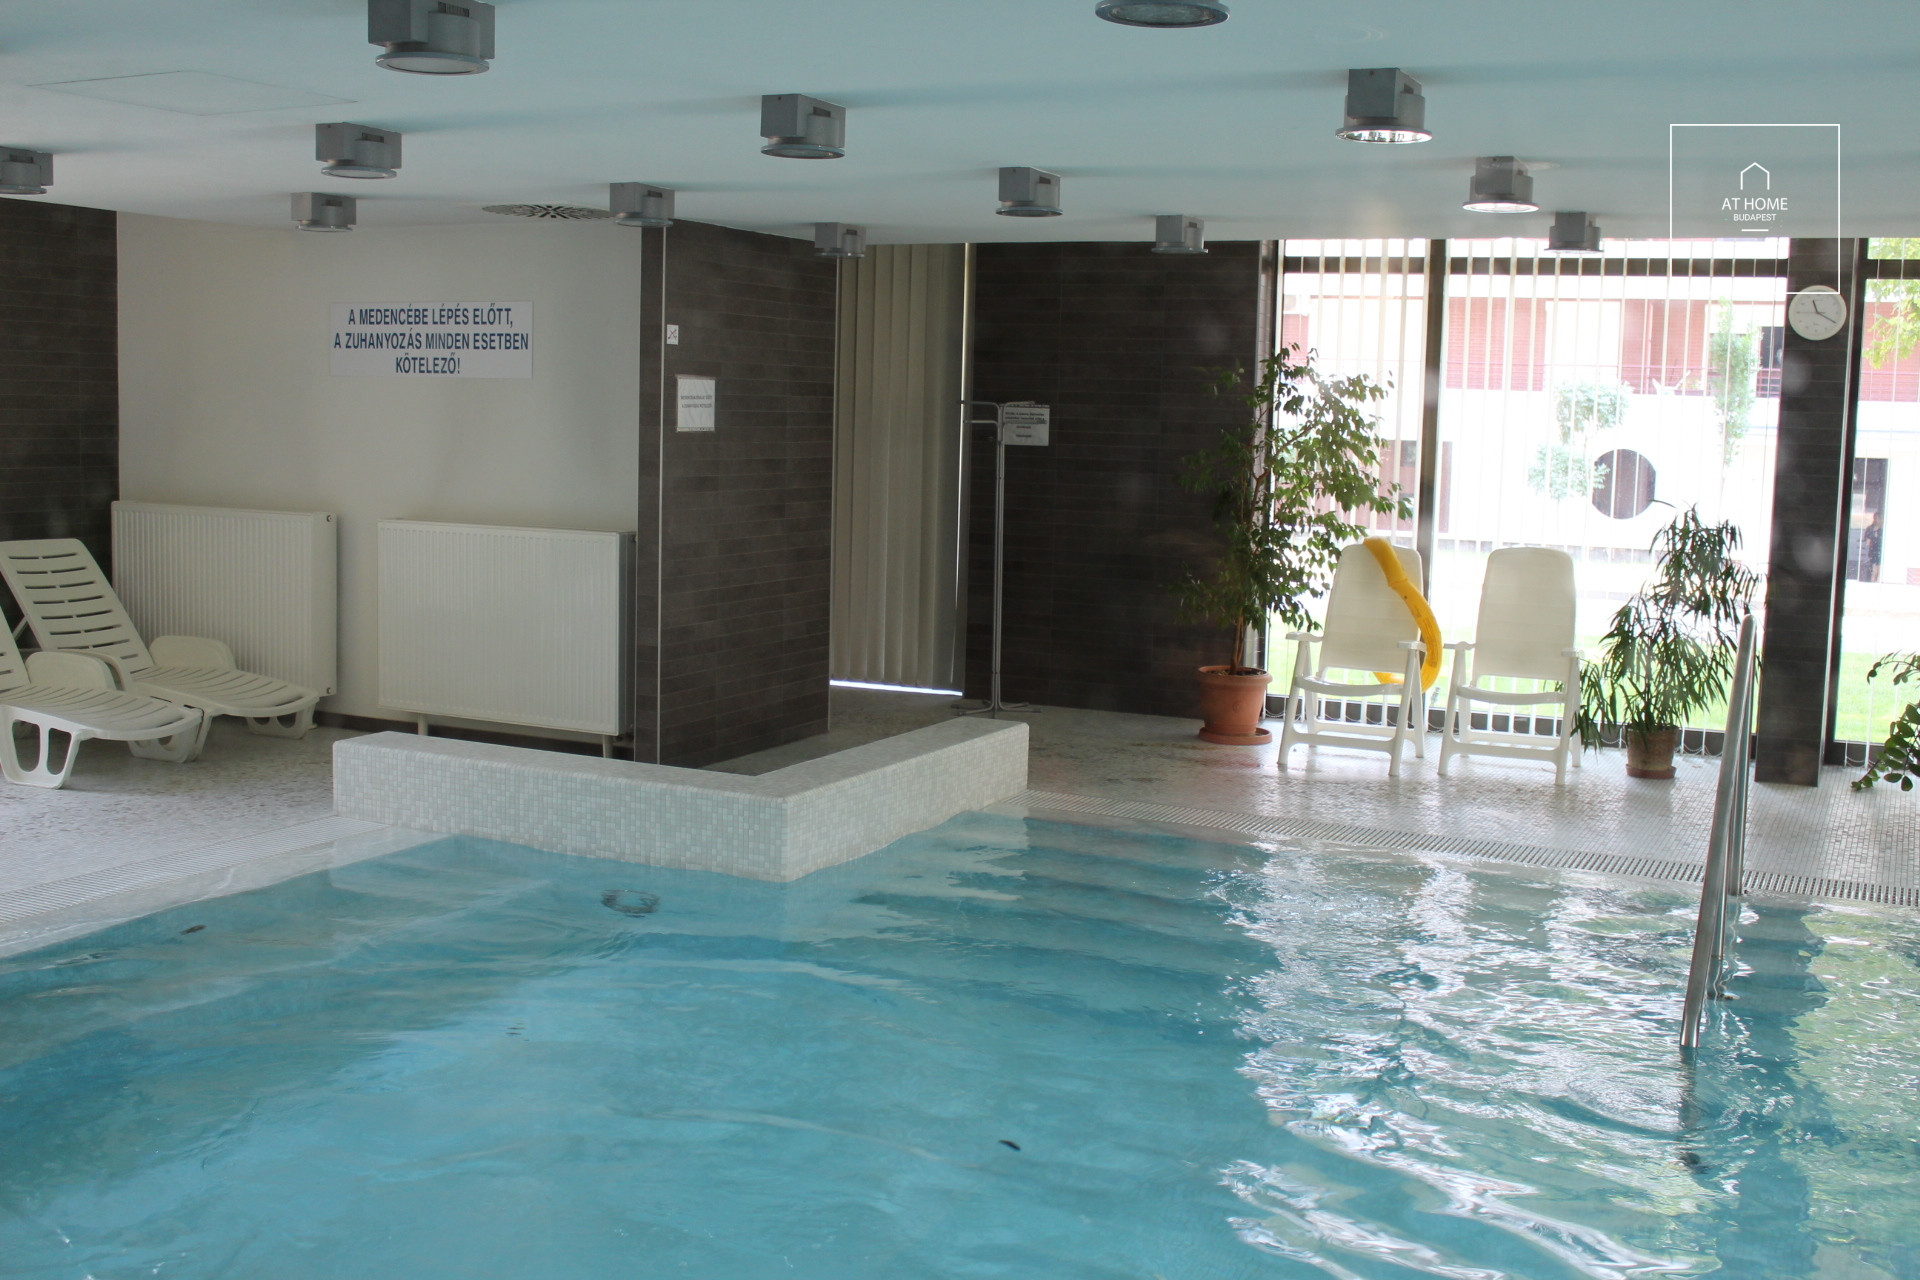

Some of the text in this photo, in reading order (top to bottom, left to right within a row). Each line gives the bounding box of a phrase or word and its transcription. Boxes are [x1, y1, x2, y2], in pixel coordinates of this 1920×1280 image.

[348, 302, 513, 328] A MEDENCÉBE LÉPÉS ELŐTT,
[333, 327, 529, 351] A ZUHANYOZÁS MINDEN ESETBEN
[395, 352, 461, 374] KÖTELEZŐ!
